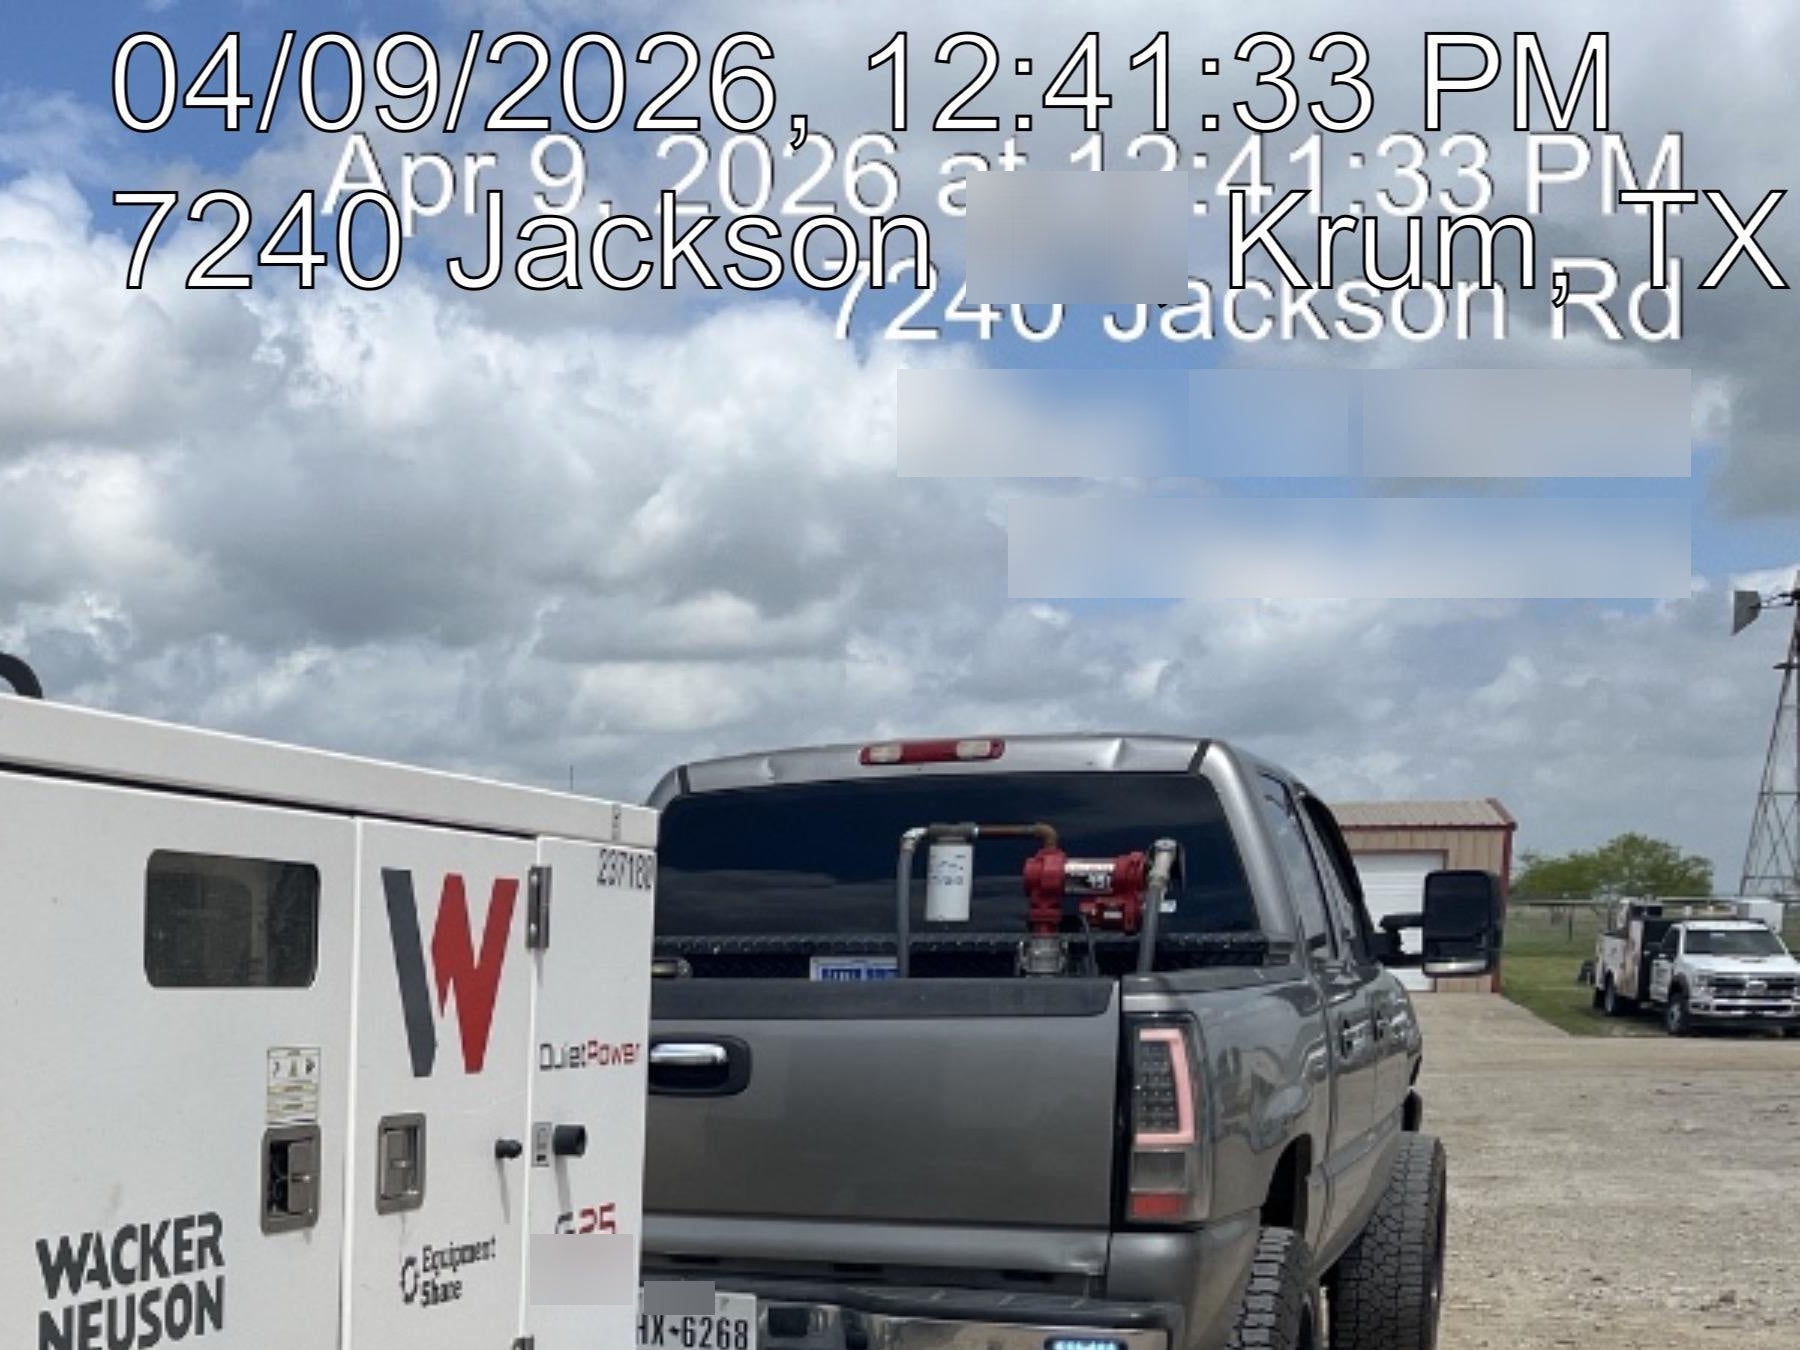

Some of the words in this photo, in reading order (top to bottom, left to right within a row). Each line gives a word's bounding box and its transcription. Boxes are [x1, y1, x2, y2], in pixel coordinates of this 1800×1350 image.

[35, 1210, 226, 1300] WACKER
[422, 1235, 496, 1278] Equipment
[421, 1278, 463, 1308] Share
